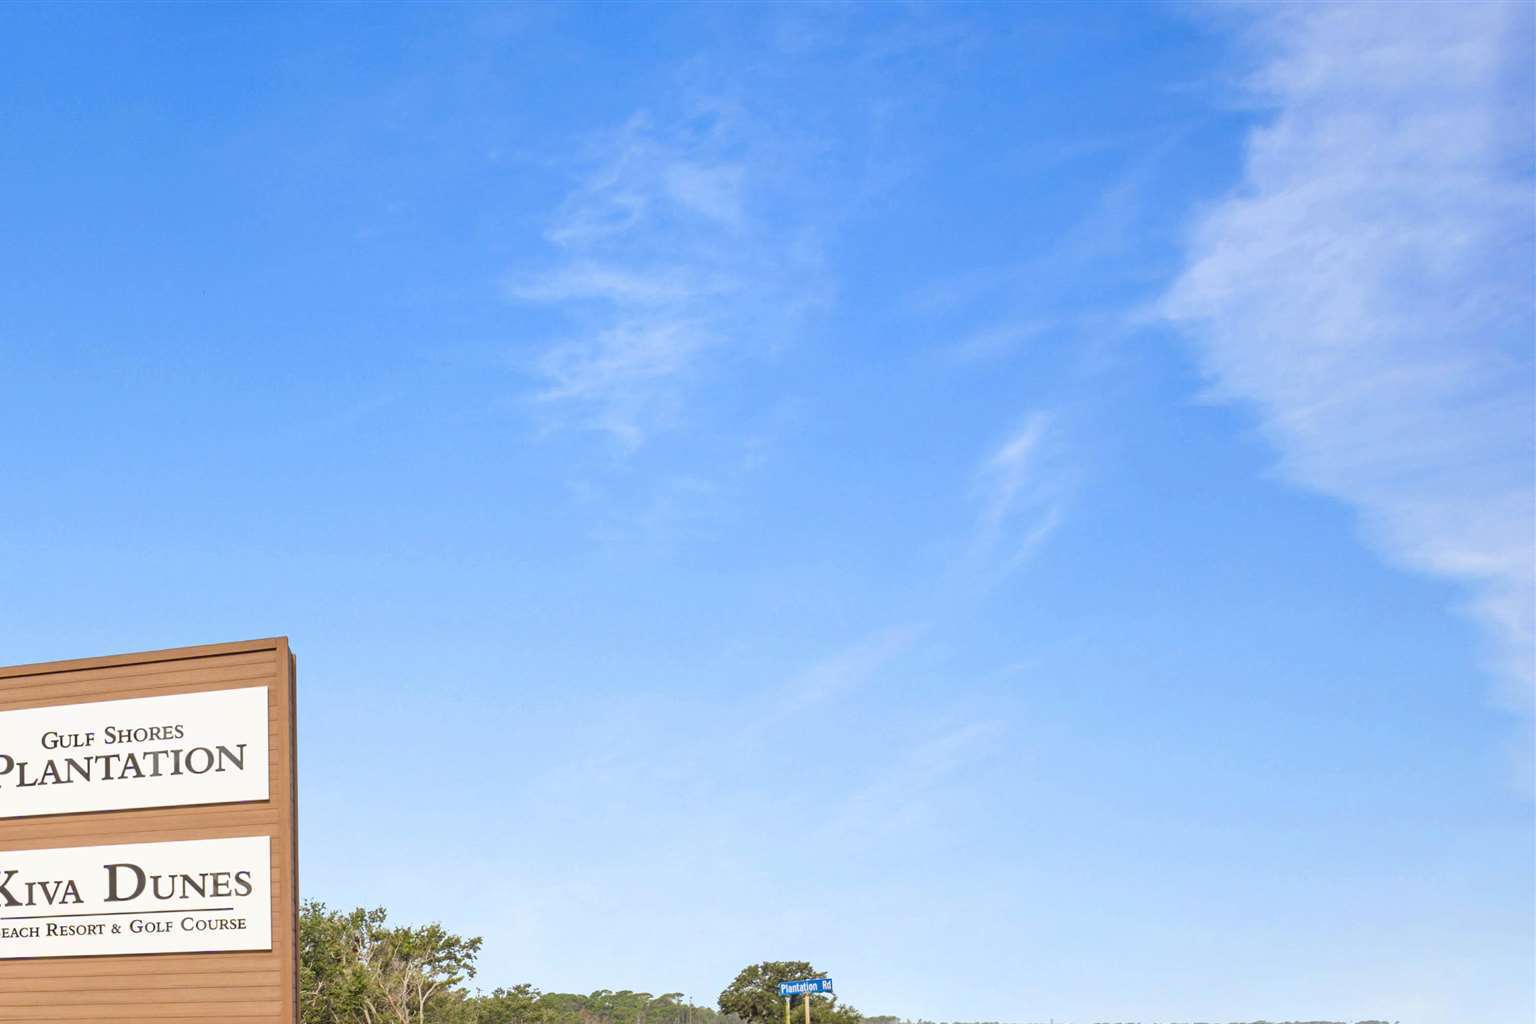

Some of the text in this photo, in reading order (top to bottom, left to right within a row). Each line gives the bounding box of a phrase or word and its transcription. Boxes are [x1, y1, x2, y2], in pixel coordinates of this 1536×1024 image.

[41, 724, 184, 750] GULF SHORES
[103, 862, 253, 903] DUNES
[46, 922, 105, 937] RESORT
[111, 923, 122, 935] &
[129, 919, 173, 934] GOLF
[180, 917, 247, 932] COURSE
[780, 980, 832, 994] Plantation Rd
